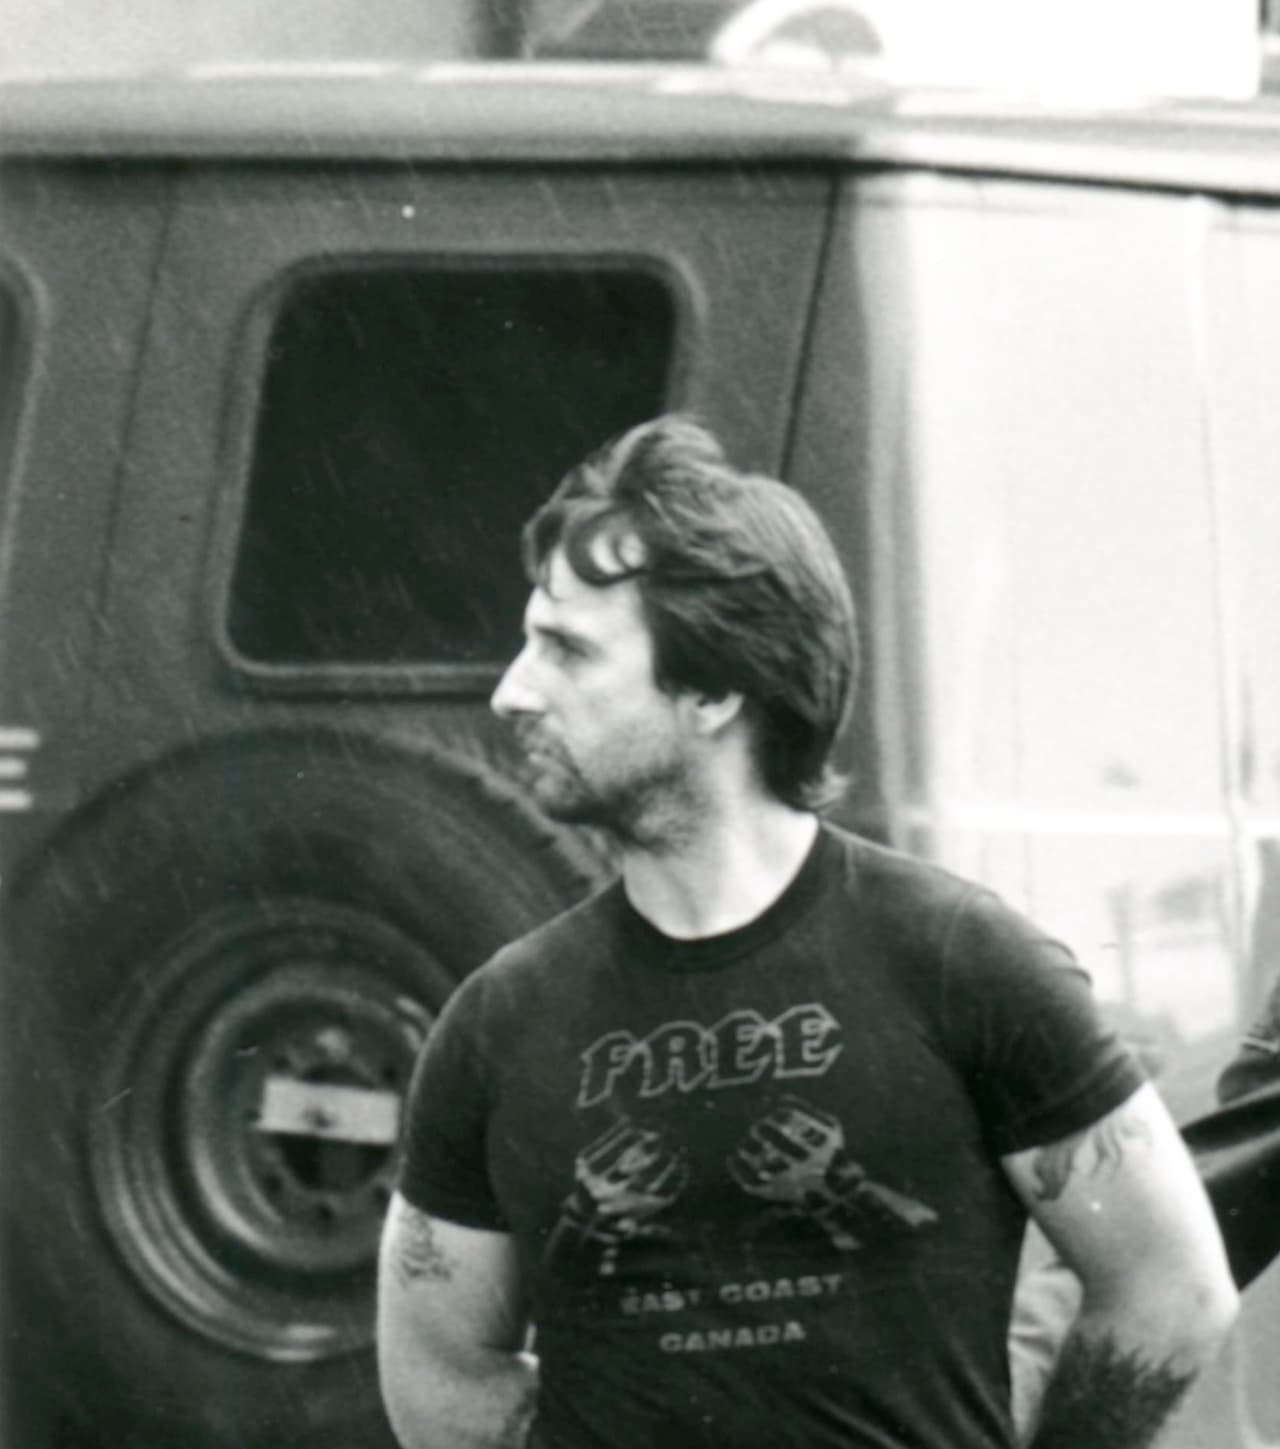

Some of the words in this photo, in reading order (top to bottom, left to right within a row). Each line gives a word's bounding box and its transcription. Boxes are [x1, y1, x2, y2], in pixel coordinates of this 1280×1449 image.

[577, 1003, 844, 1108] FREE
[621, 1286, 700, 1314] EAST
[718, 1274, 843, 1303] COAST
[659, 1321, 807, 1352] CANADA
